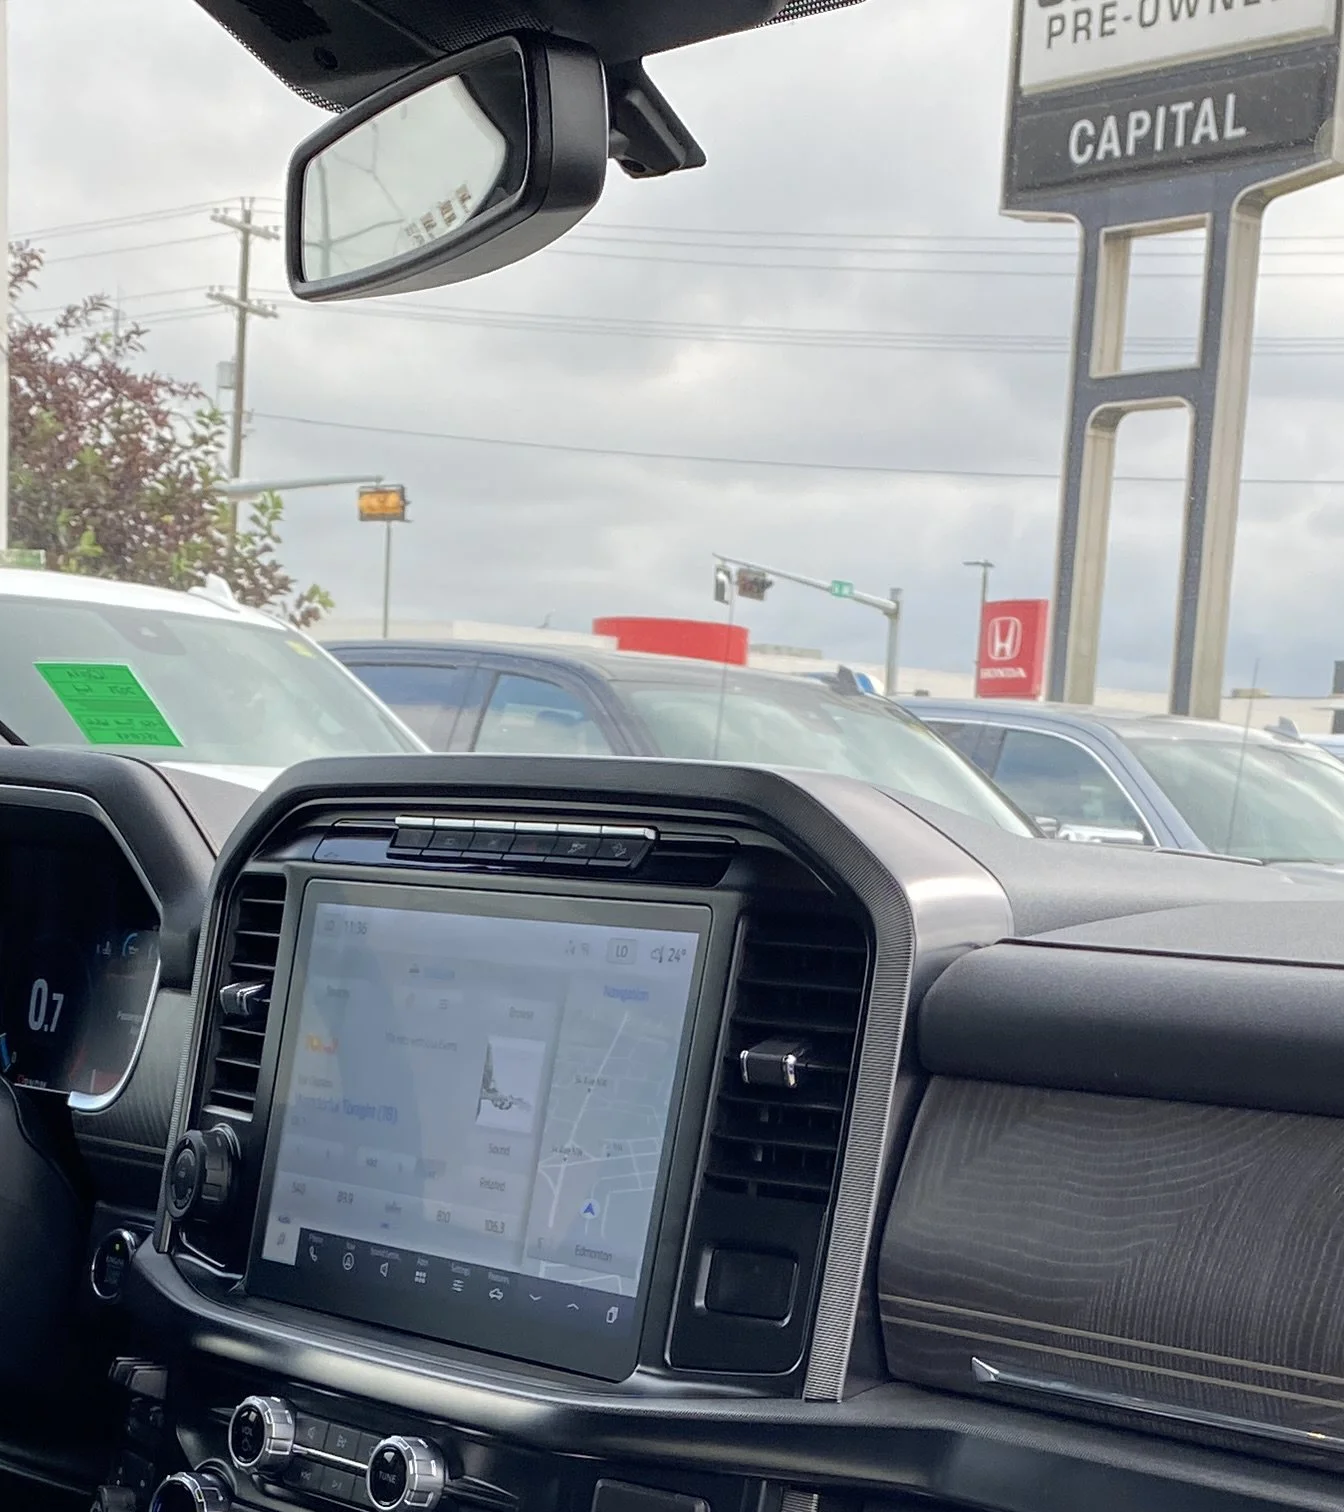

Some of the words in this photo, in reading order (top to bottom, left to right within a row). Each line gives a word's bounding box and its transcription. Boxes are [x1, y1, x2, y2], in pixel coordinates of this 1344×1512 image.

[1046, 0, 1271, 49] PRE-OW
[1068, 93, 1247, 165] CAPITAL
[979, 667, 1027, 679] HONDA
[615, 944, 629, 958] LO
[28, 978, 64, 1033] 0.7
[575, 1244, 613, 1262] Edmonton
[378, 1471, 397, 1485] TUNE
